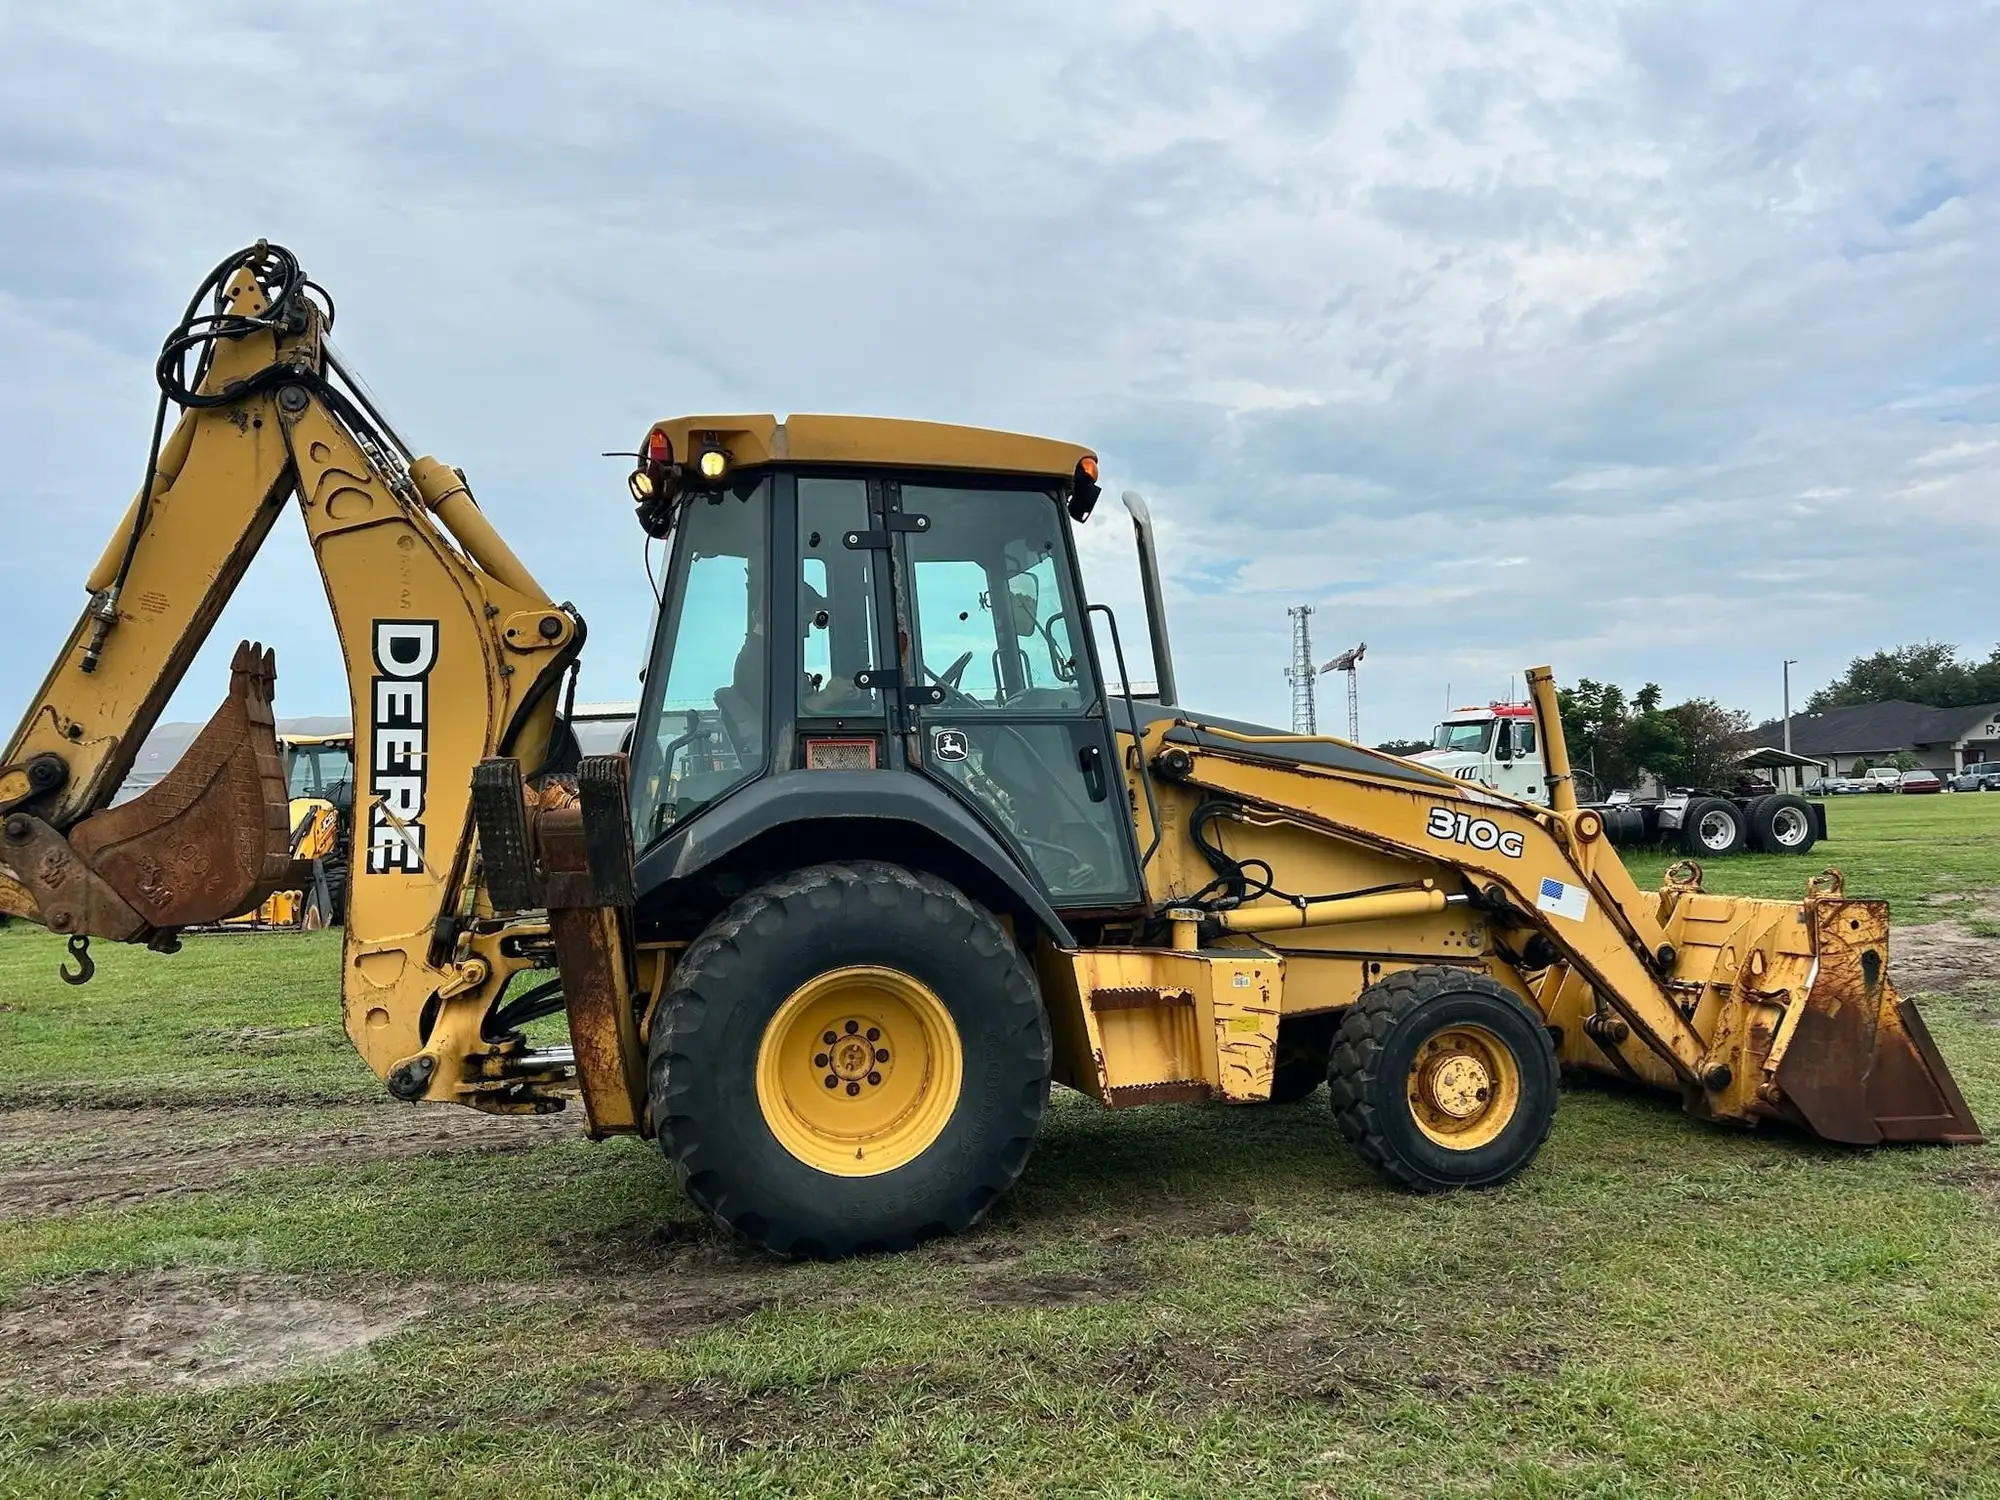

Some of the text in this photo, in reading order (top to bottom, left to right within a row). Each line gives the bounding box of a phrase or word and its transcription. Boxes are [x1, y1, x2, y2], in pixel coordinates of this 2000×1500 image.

[370, 622, 435, 870] DEERE
[321, 810, 336, 833] JCB
[1427, 806, 1525, 859] 310G
